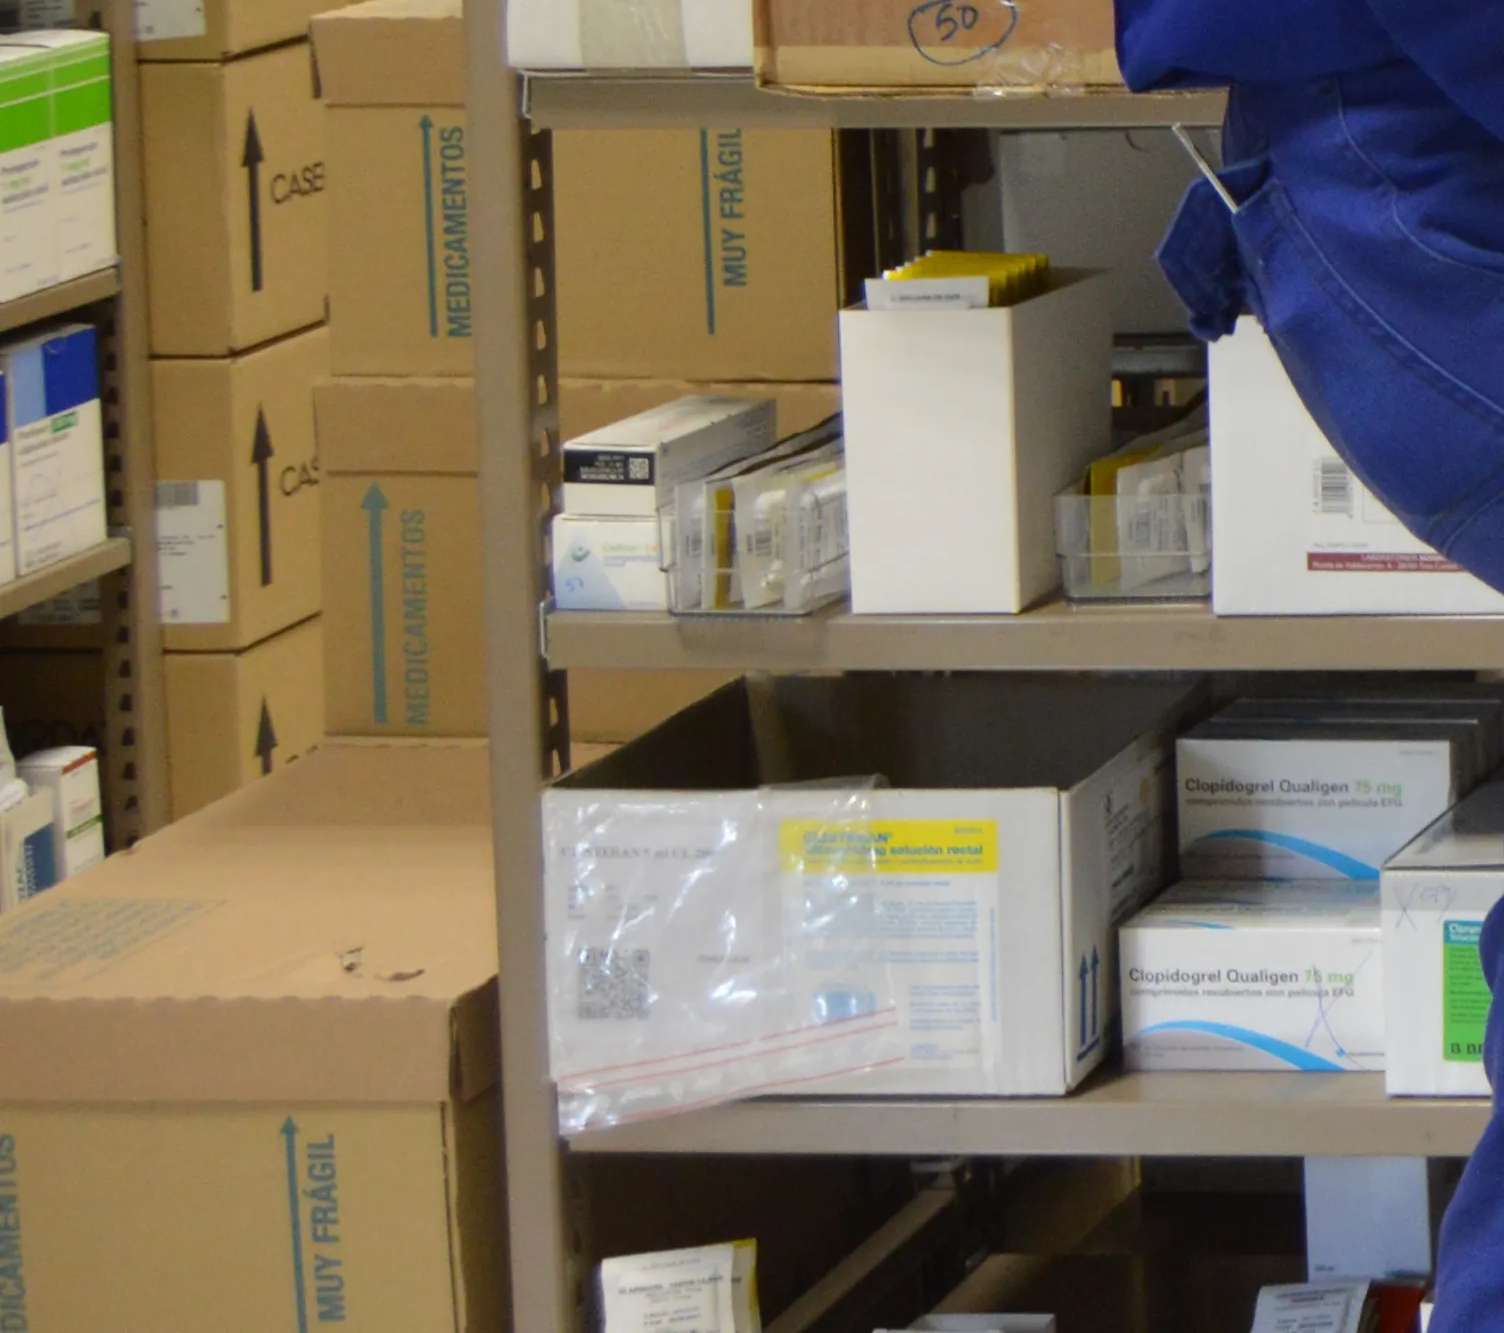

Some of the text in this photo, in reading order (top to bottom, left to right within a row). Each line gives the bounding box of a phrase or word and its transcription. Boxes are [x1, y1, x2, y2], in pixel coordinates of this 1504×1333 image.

[270, 161, 326, 206] CASE
[439, 125, 472, 339] MEDICAMENTOS
[717, 124, 747, 289] MUY FRÁGIL
[403, 505, 428, 726] MEDICAMENTOS
[1184, 777, 1402, 798] Clopidogrel Qualigen 75 mg
[1128, 965, 1223, 989] Clopidogrel
[1226, 967, 1300, 989] Qualigen
[1327, 972, 1354, 989] mg
[303, 1134, 349, 1325] MUY FRÁGIL
